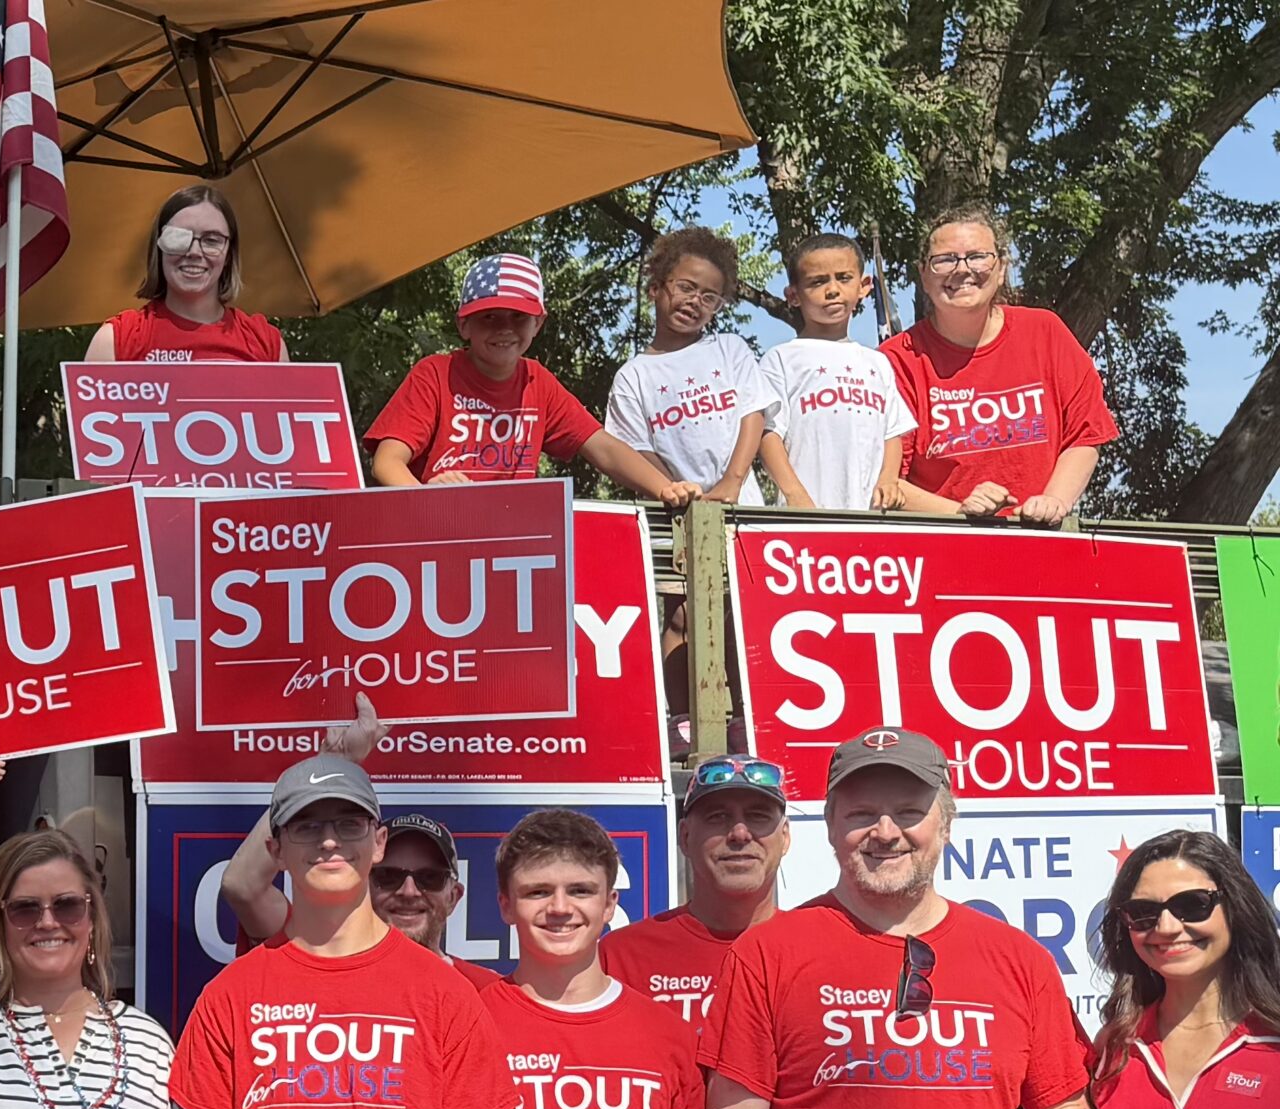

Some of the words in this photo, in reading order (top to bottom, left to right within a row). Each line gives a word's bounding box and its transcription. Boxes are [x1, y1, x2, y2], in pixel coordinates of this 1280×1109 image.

[76, 375, 169, 405] Stacey
[678, 385, 710, 399] TEAM
[835, 376, 865, 385] TEAM
[929, 386, 975, 402] Stacey
[648, 389, 737, 433] HOUSLE
[800, 387, 886, 414] HOUSLEY
[932, 389, 1044, 431] STOUT
[81, 411, 341, 466] STOUT
[926, 435, 950, 460] for
[947, 414, 1048, 449] HOUSE
[212, 518, 332, 555] Stacey
[763, 539, 924, 607] Stacey
[209, 554, 556, 648] STOUT
[283, 660, 325, 698] for
[321, 649, 478, 687] HOUSE
[770, 610, 1180, 732] STOUT
[234, 730, 587, 754] HouslorSenate.com
[943, 836, 1072, 880] NATE
[649, 975, 712, 992] Stacey
[820, 985, 892, 1008] Stacey
[251, 1003, 316, 1024] Stacey
[823, 1010, 994, 1047] STOUT
[251, 1022, 415, 1066] STOUT
[507, 1053, 560, 1073] tacey
[813, 1053, 847, 1088] for
[845, 1049, 992, 1082] HOUSE
[242, 1073, 273, 1109] for
[272, 1064, 404, 1100] HOUSE
[1226, 1076, 1261, 1088] STOUT
